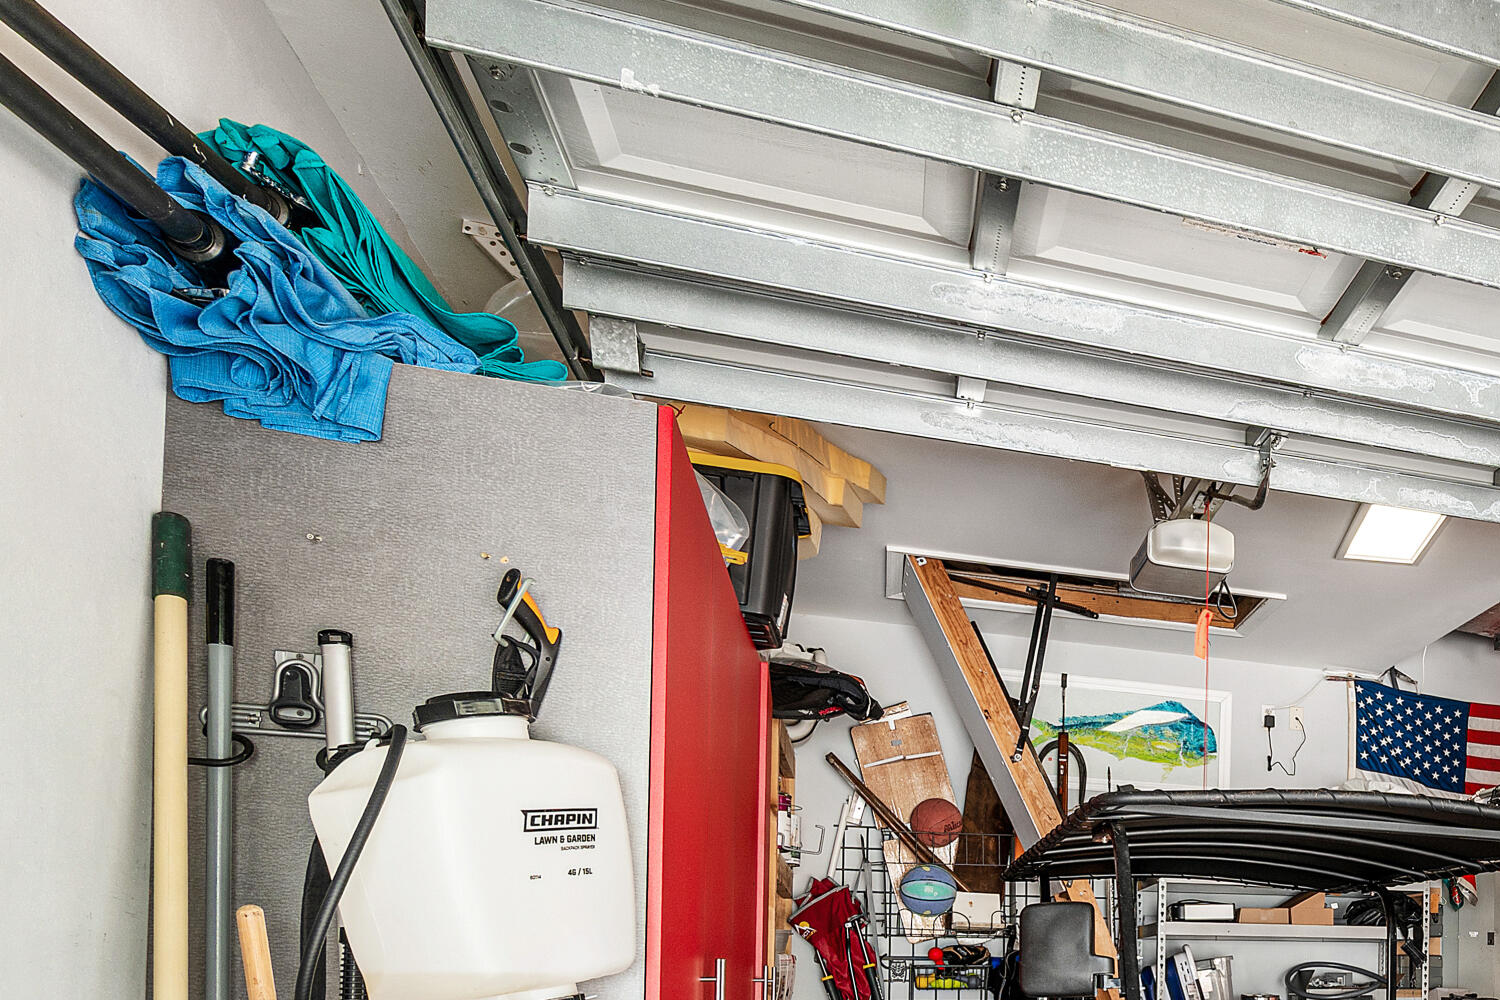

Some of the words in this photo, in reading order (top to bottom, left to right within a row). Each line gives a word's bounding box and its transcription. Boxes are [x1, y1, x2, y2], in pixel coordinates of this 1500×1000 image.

[530, 813, 593, 826] CHAPIN
[534, 835, 558, 845] LAWN
[559, 835, 565, 843] &
[567, 834, 596, 843] GARDEN
[567, 868, 577, 876] 4G
[582, 867, 593, 875] 15L
